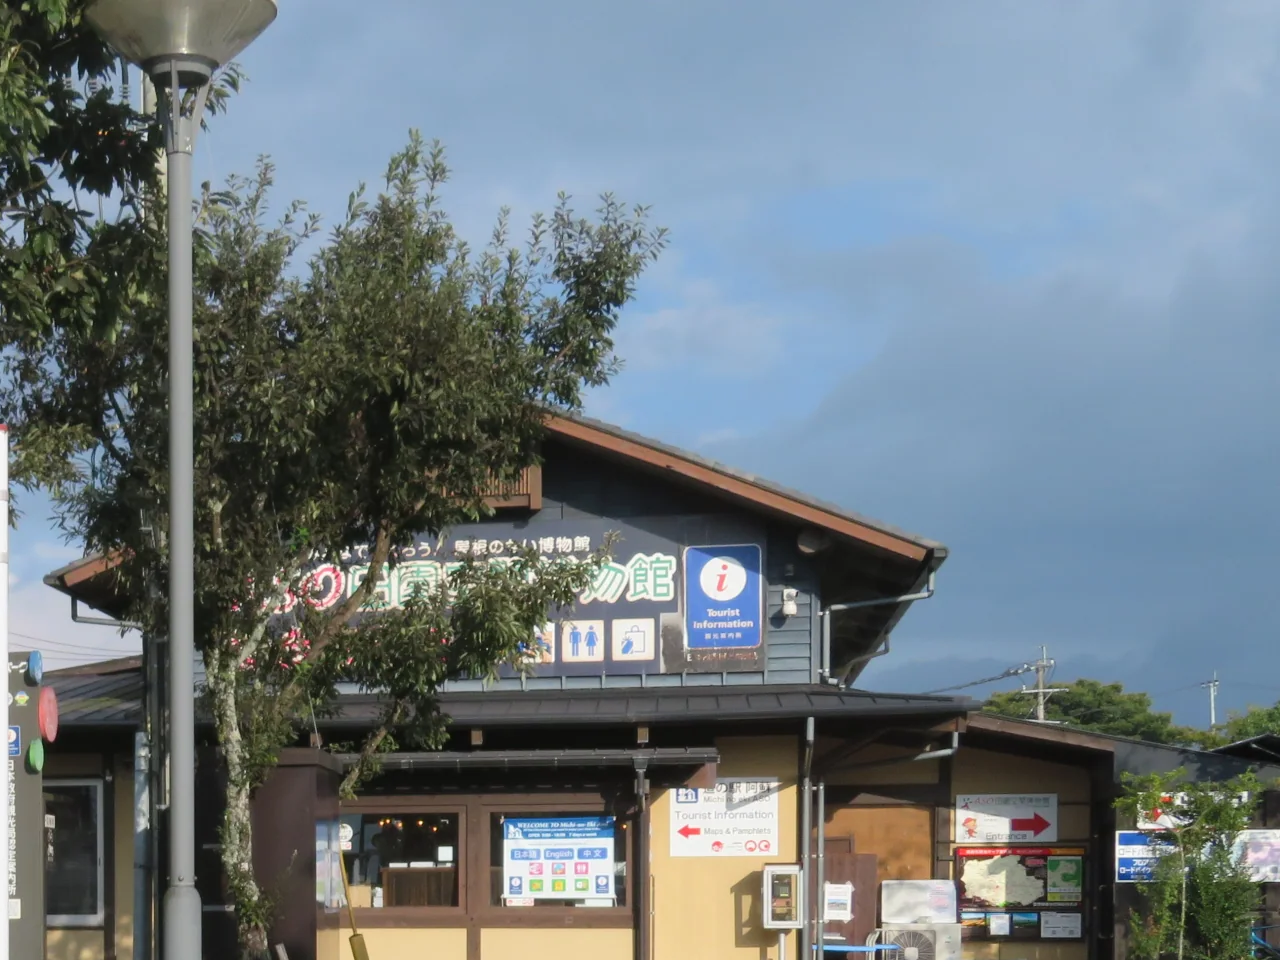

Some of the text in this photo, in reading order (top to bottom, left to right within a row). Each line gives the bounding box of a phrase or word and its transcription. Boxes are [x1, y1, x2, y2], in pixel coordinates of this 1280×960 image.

[706, 608, 741, 618] Tourist
[693, 619, 754, 629] Information
[675, 810, 774, 820] Tourist Information
[703, 827, 723, 836] Maps
[732, 827, 772, 836] Pamphlets
[985, 831, 1028, 840] Entrance
[545, 850, 573, 859] English
[583, 849, 602, 858] 中文
